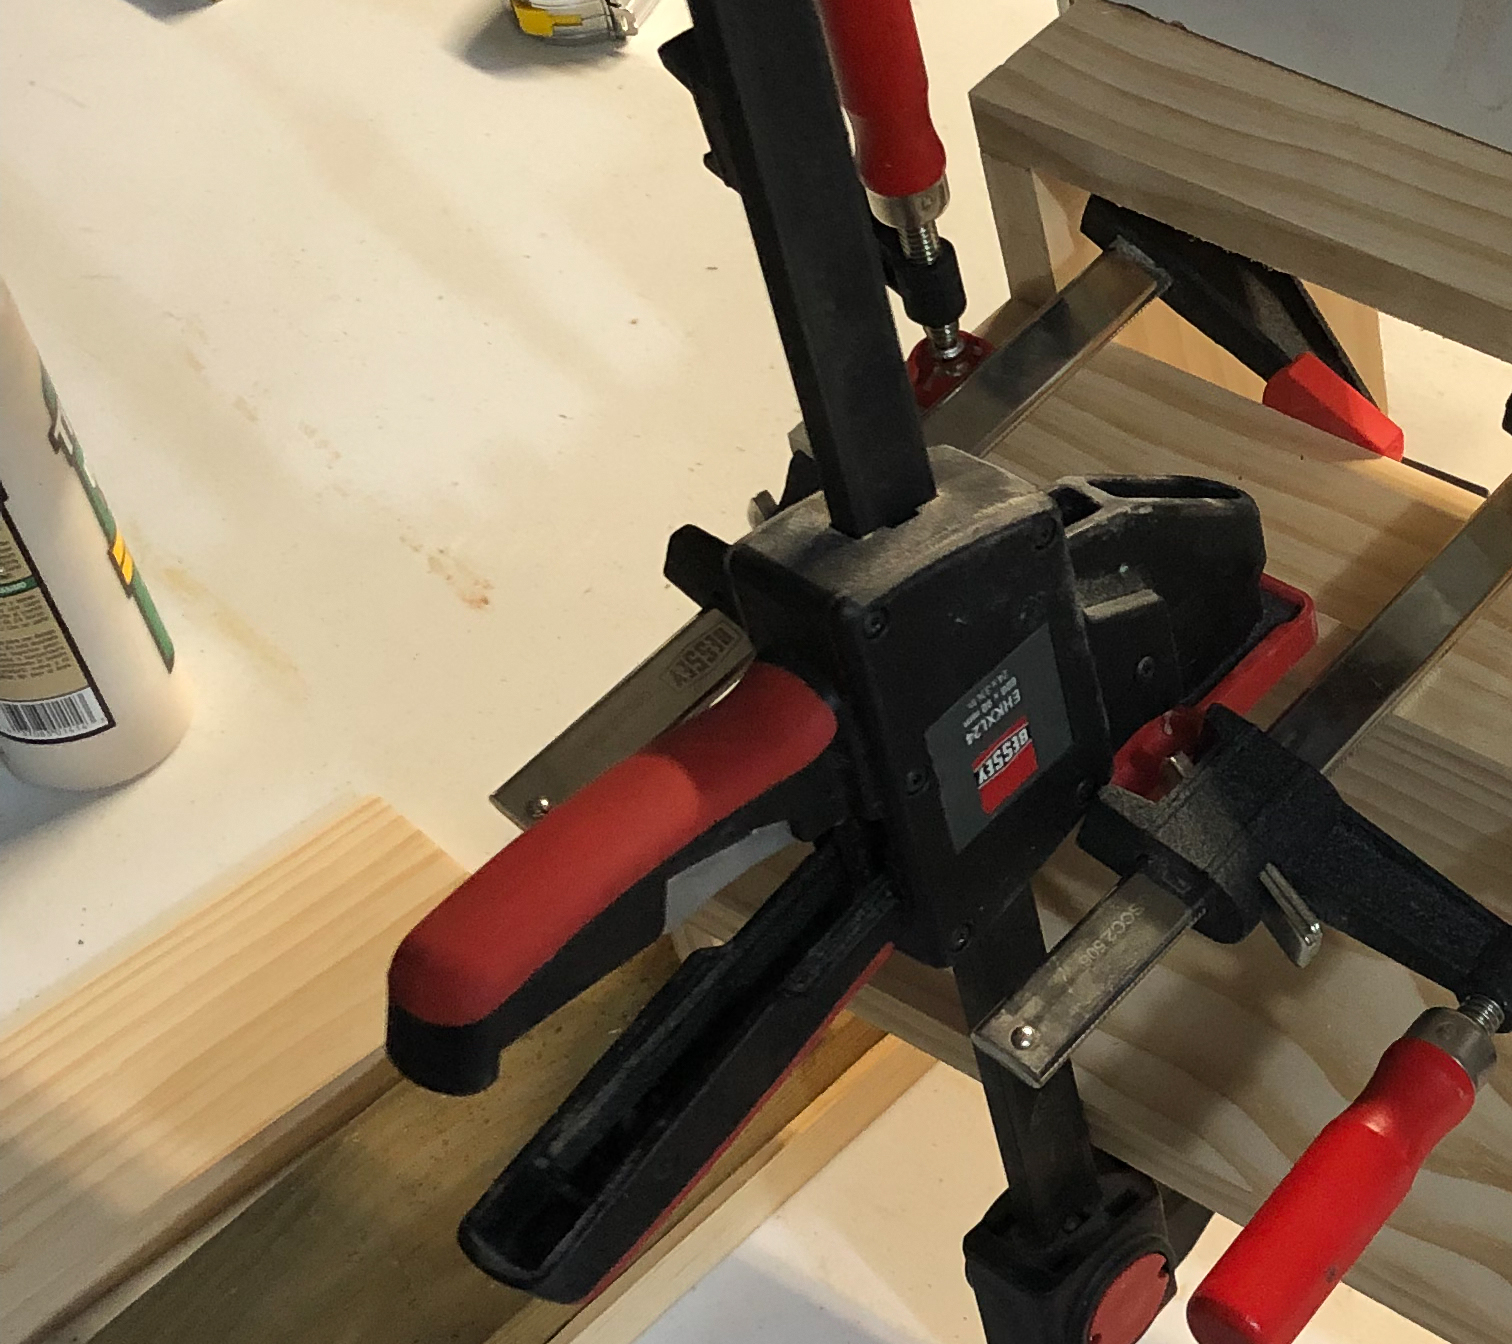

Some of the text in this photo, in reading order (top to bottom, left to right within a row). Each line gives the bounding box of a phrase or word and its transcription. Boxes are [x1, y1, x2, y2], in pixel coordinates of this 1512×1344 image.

[965, 688, 1021, 746] EHKXL24
[978, 727, 1029, 784] BESSEY
[1080, 903, 1145, 968] SCC2.506
